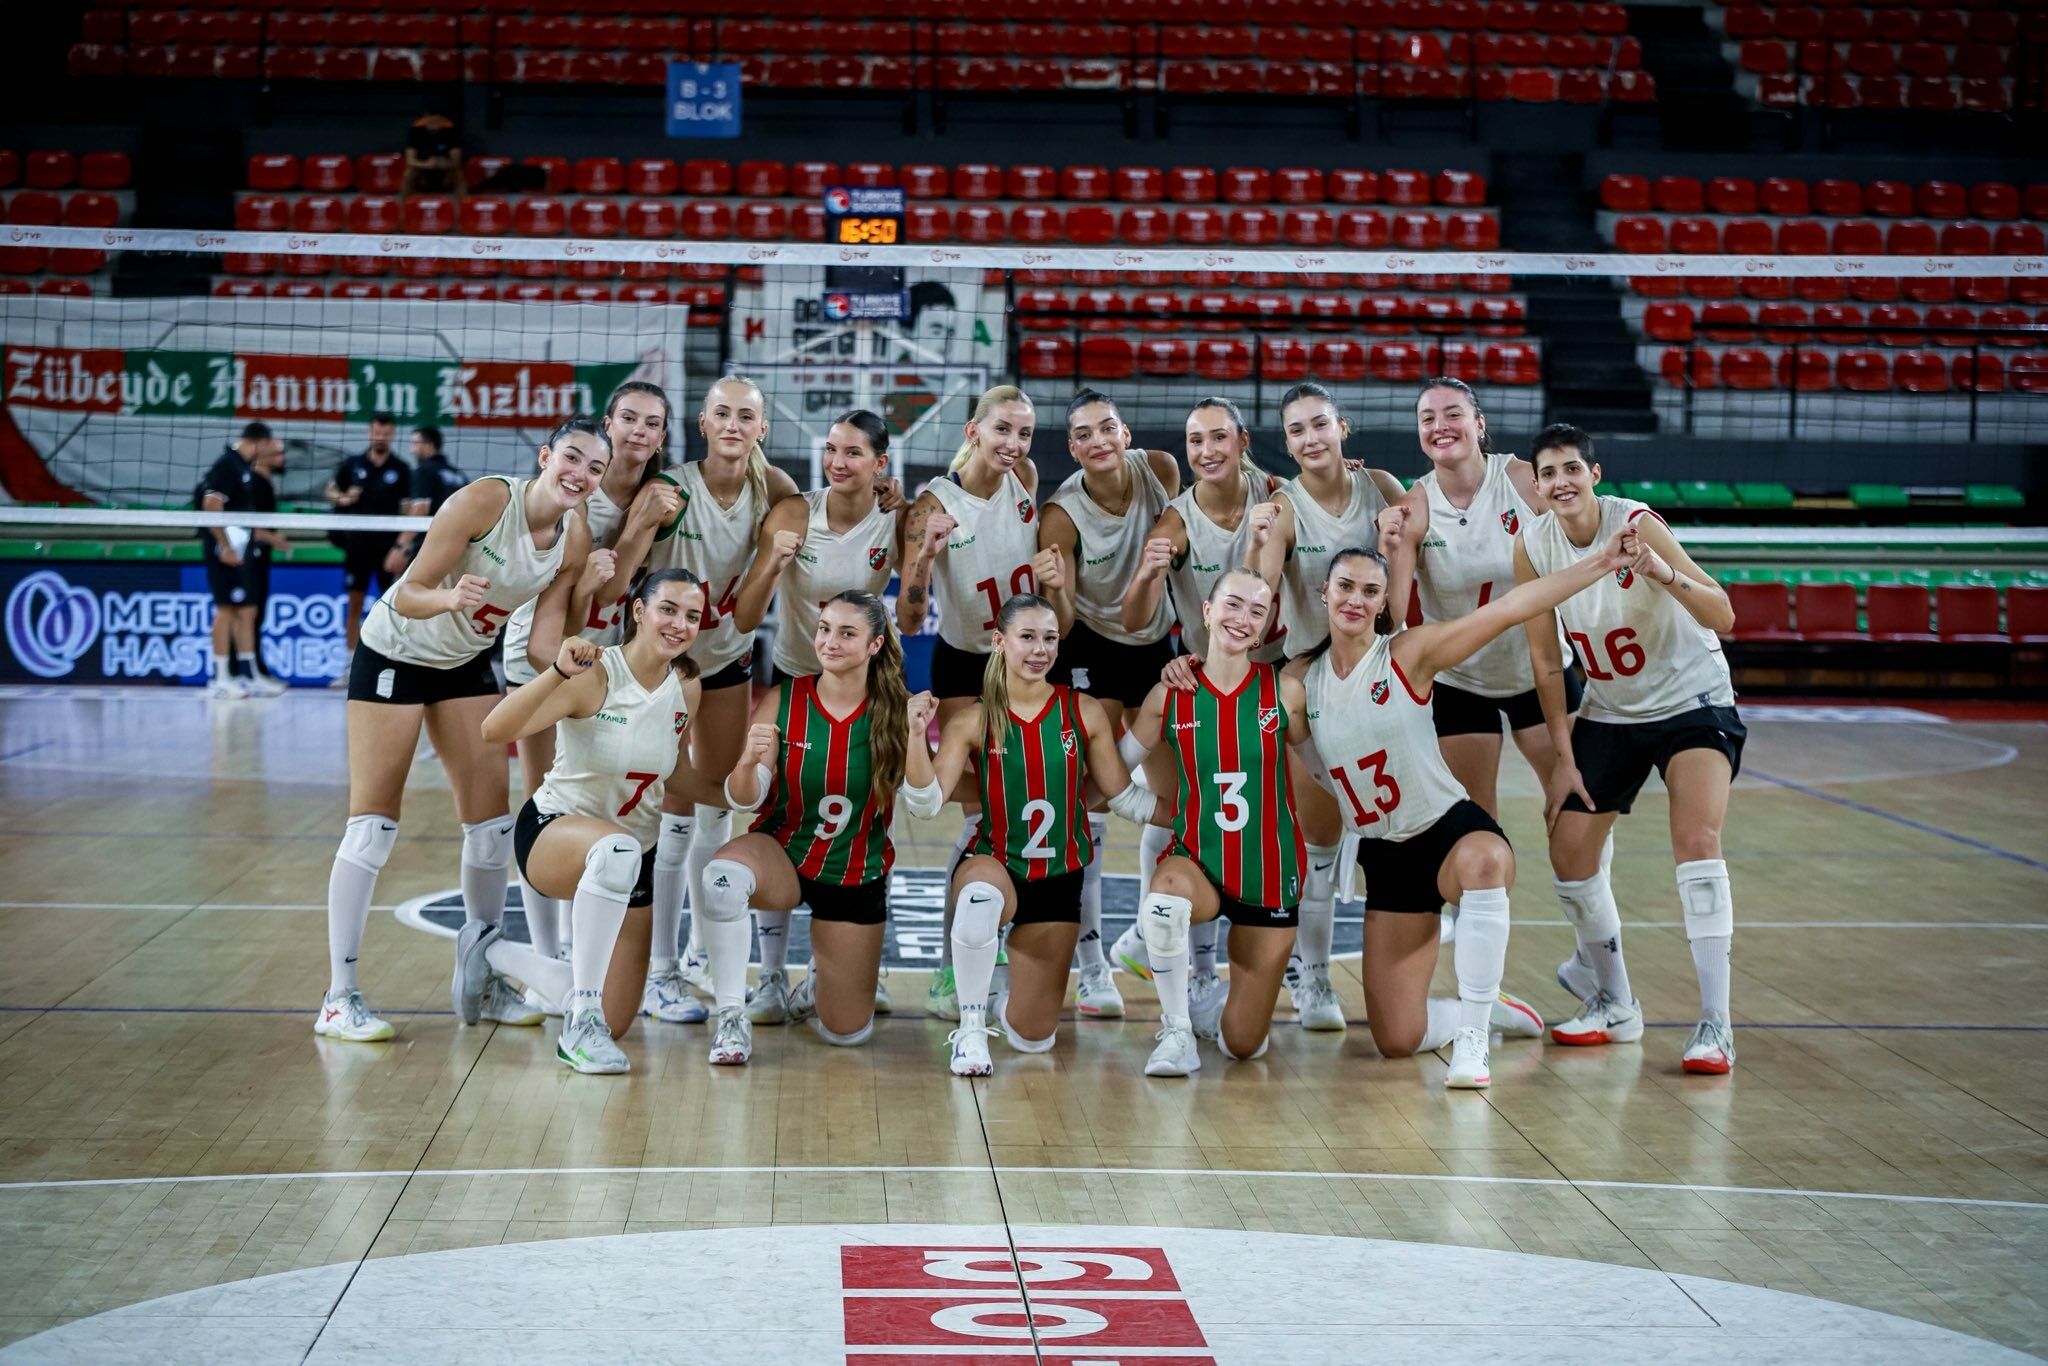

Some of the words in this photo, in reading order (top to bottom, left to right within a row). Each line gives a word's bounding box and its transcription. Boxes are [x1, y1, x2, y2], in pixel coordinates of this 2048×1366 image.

[673, 101, 733, 120] BLOK
[7, 351, 193, 416] Zübeyde
[472, 604, 510, 634] 5
[1570, 627, 1646, 681] 16
[602, 714, 627, 725] KANIJE
[617, 771, 659, 817] 7
[1213, 772, 1250, 832] 3
[1330, 749, 1401, 827] 13
[814, 794, 853, 840] 9
[1021, 799, 1056, 859] 2
